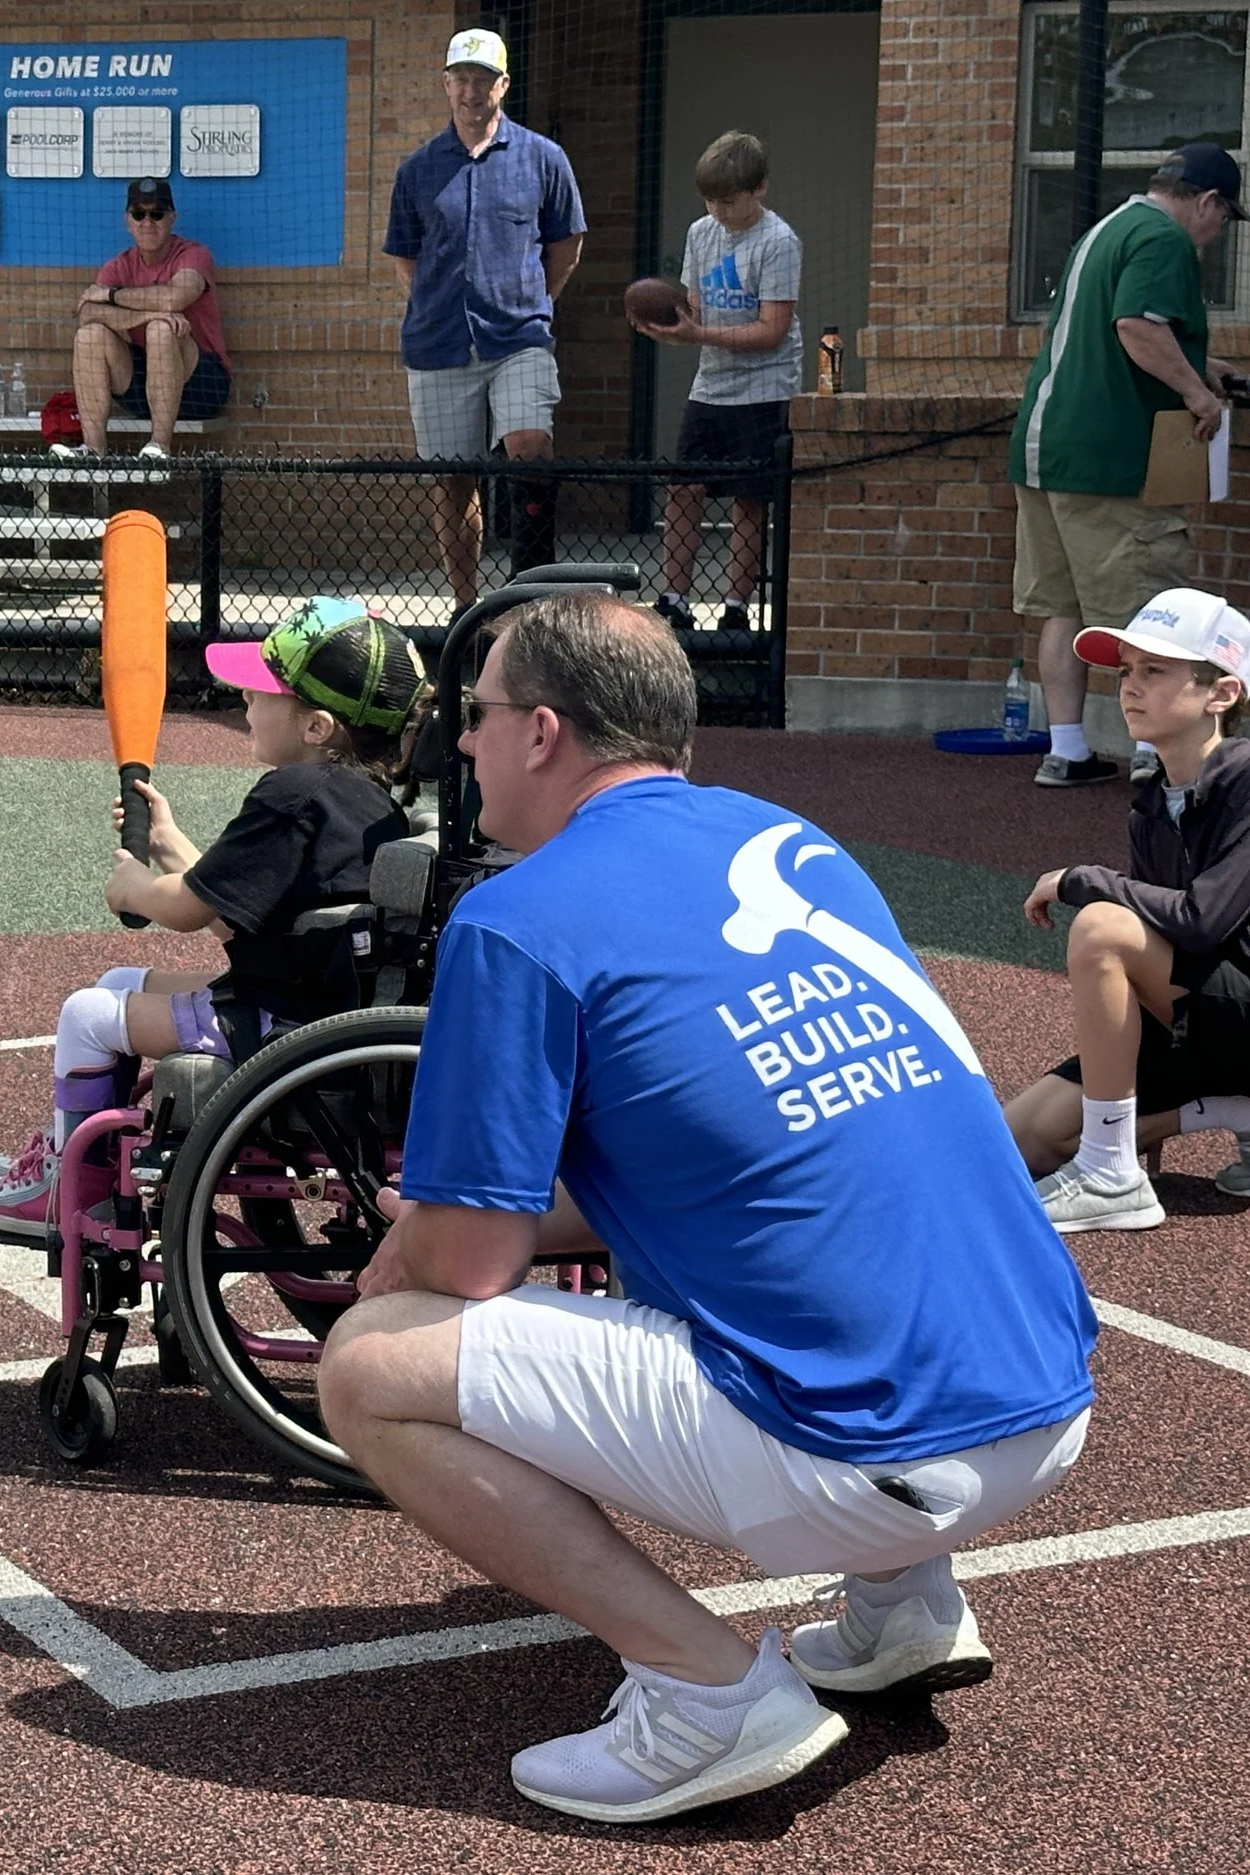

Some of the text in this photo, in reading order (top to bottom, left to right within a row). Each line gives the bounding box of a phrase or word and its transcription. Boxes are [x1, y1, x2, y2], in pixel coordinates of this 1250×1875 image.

[10, 54, 173, 79] HOME RUN
[4, 87, 51, 99] Generous
[54, 86, 78, 98] Gifts
[80, 88, 90, 98] at
[137, 88, 149, 97] or
[151, 87, 178, 97] more
[22, 134, 79, 146] POOLCORP
[186, 126, 253, 153] STIRLING
[716, 963, 868, 1042] LEAD.
[745, 1002, 909, 1088] BUILD.
[777, 1045, 943, 1132] SERVE.
